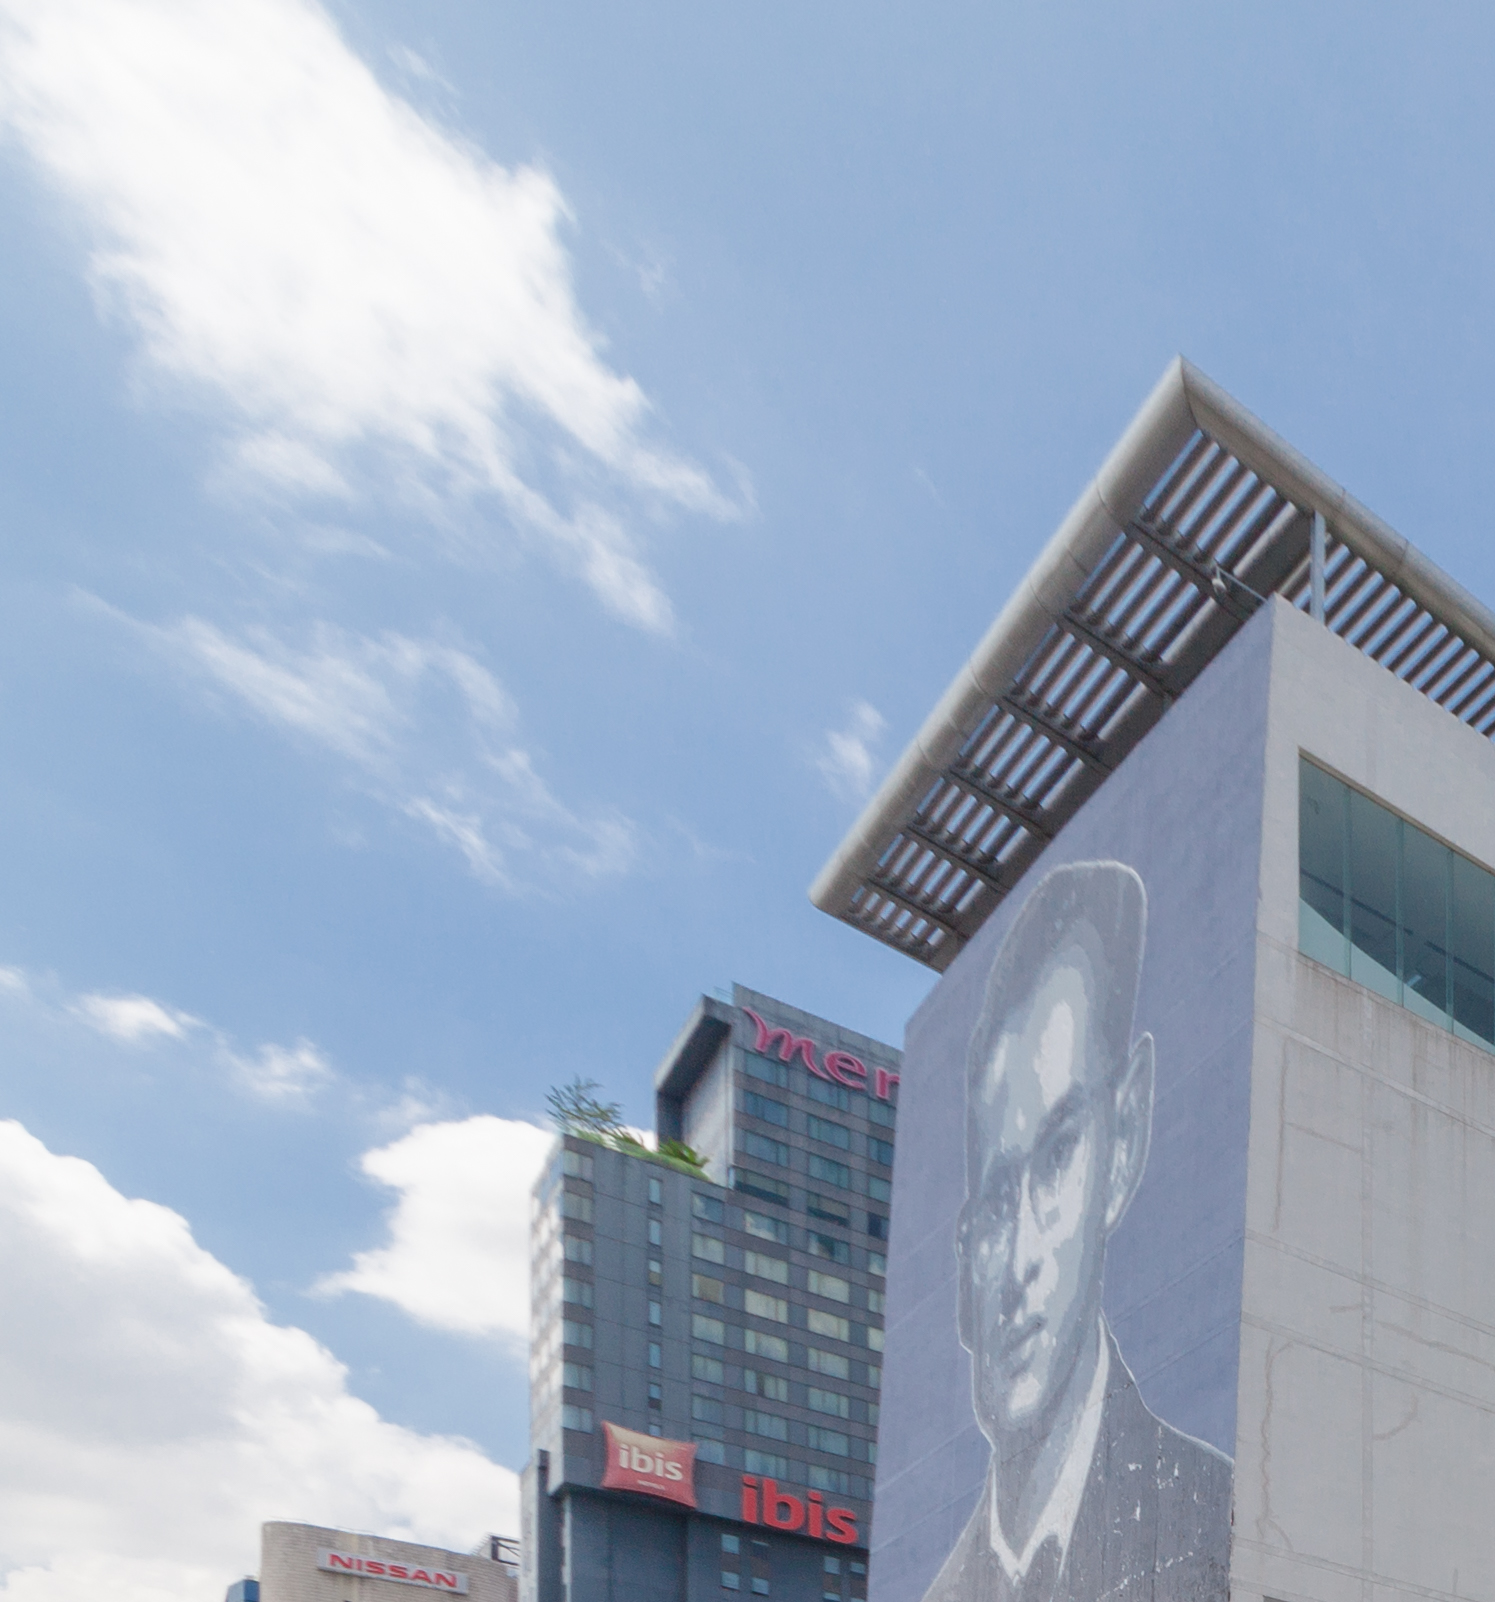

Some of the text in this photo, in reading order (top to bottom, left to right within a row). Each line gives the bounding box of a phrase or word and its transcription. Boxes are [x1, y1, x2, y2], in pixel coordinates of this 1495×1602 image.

[618, 1443, 685, 1481] ibis
[741, 1473, 859, 1545] ibis
[328, 1553, 459, 1588] NISSAN
